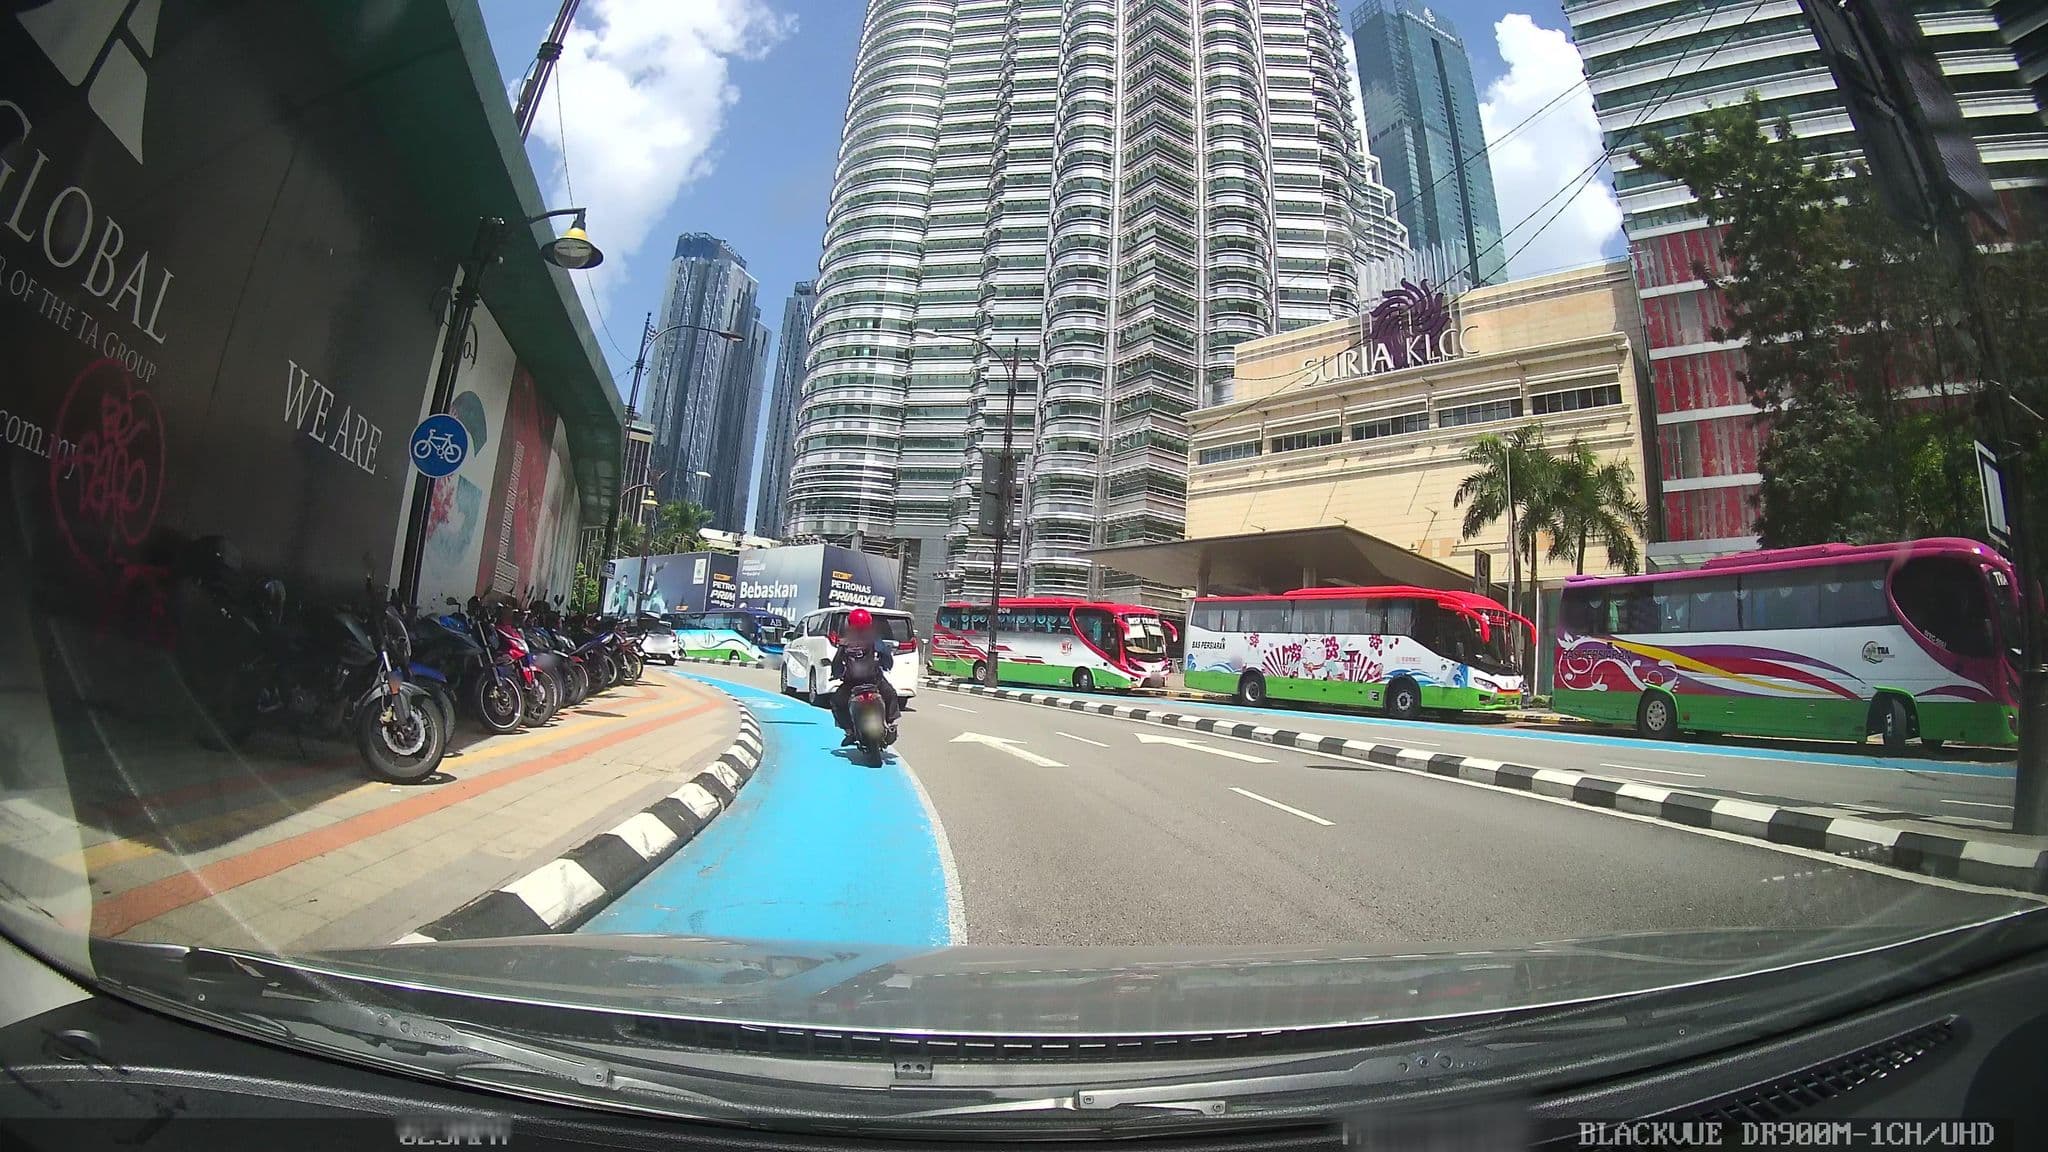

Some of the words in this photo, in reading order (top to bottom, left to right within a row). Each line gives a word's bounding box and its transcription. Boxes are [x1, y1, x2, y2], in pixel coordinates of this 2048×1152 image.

[10, 270, 37, 302] OF
[40, 288, 75, 331] THE
[78, 311, 100, 349] TA
[1302, 342, 1395, 387] SURIA
[1406, 325, 1480, 365] KLCC
[285, 359, 335, 444] WE
[329, 405, 382, 475] ARE
[740, 580, 798, 598] Bebaskan
[831, 579, 872, 594] PETRONAS
[1192, 641, 1201, 649] BAS
[1201, 641, 1225, 650] PERSIARAN
[1562, 649, 1578, 660] BAS
[1583, 648, 1632, 660] PERSIARAN
